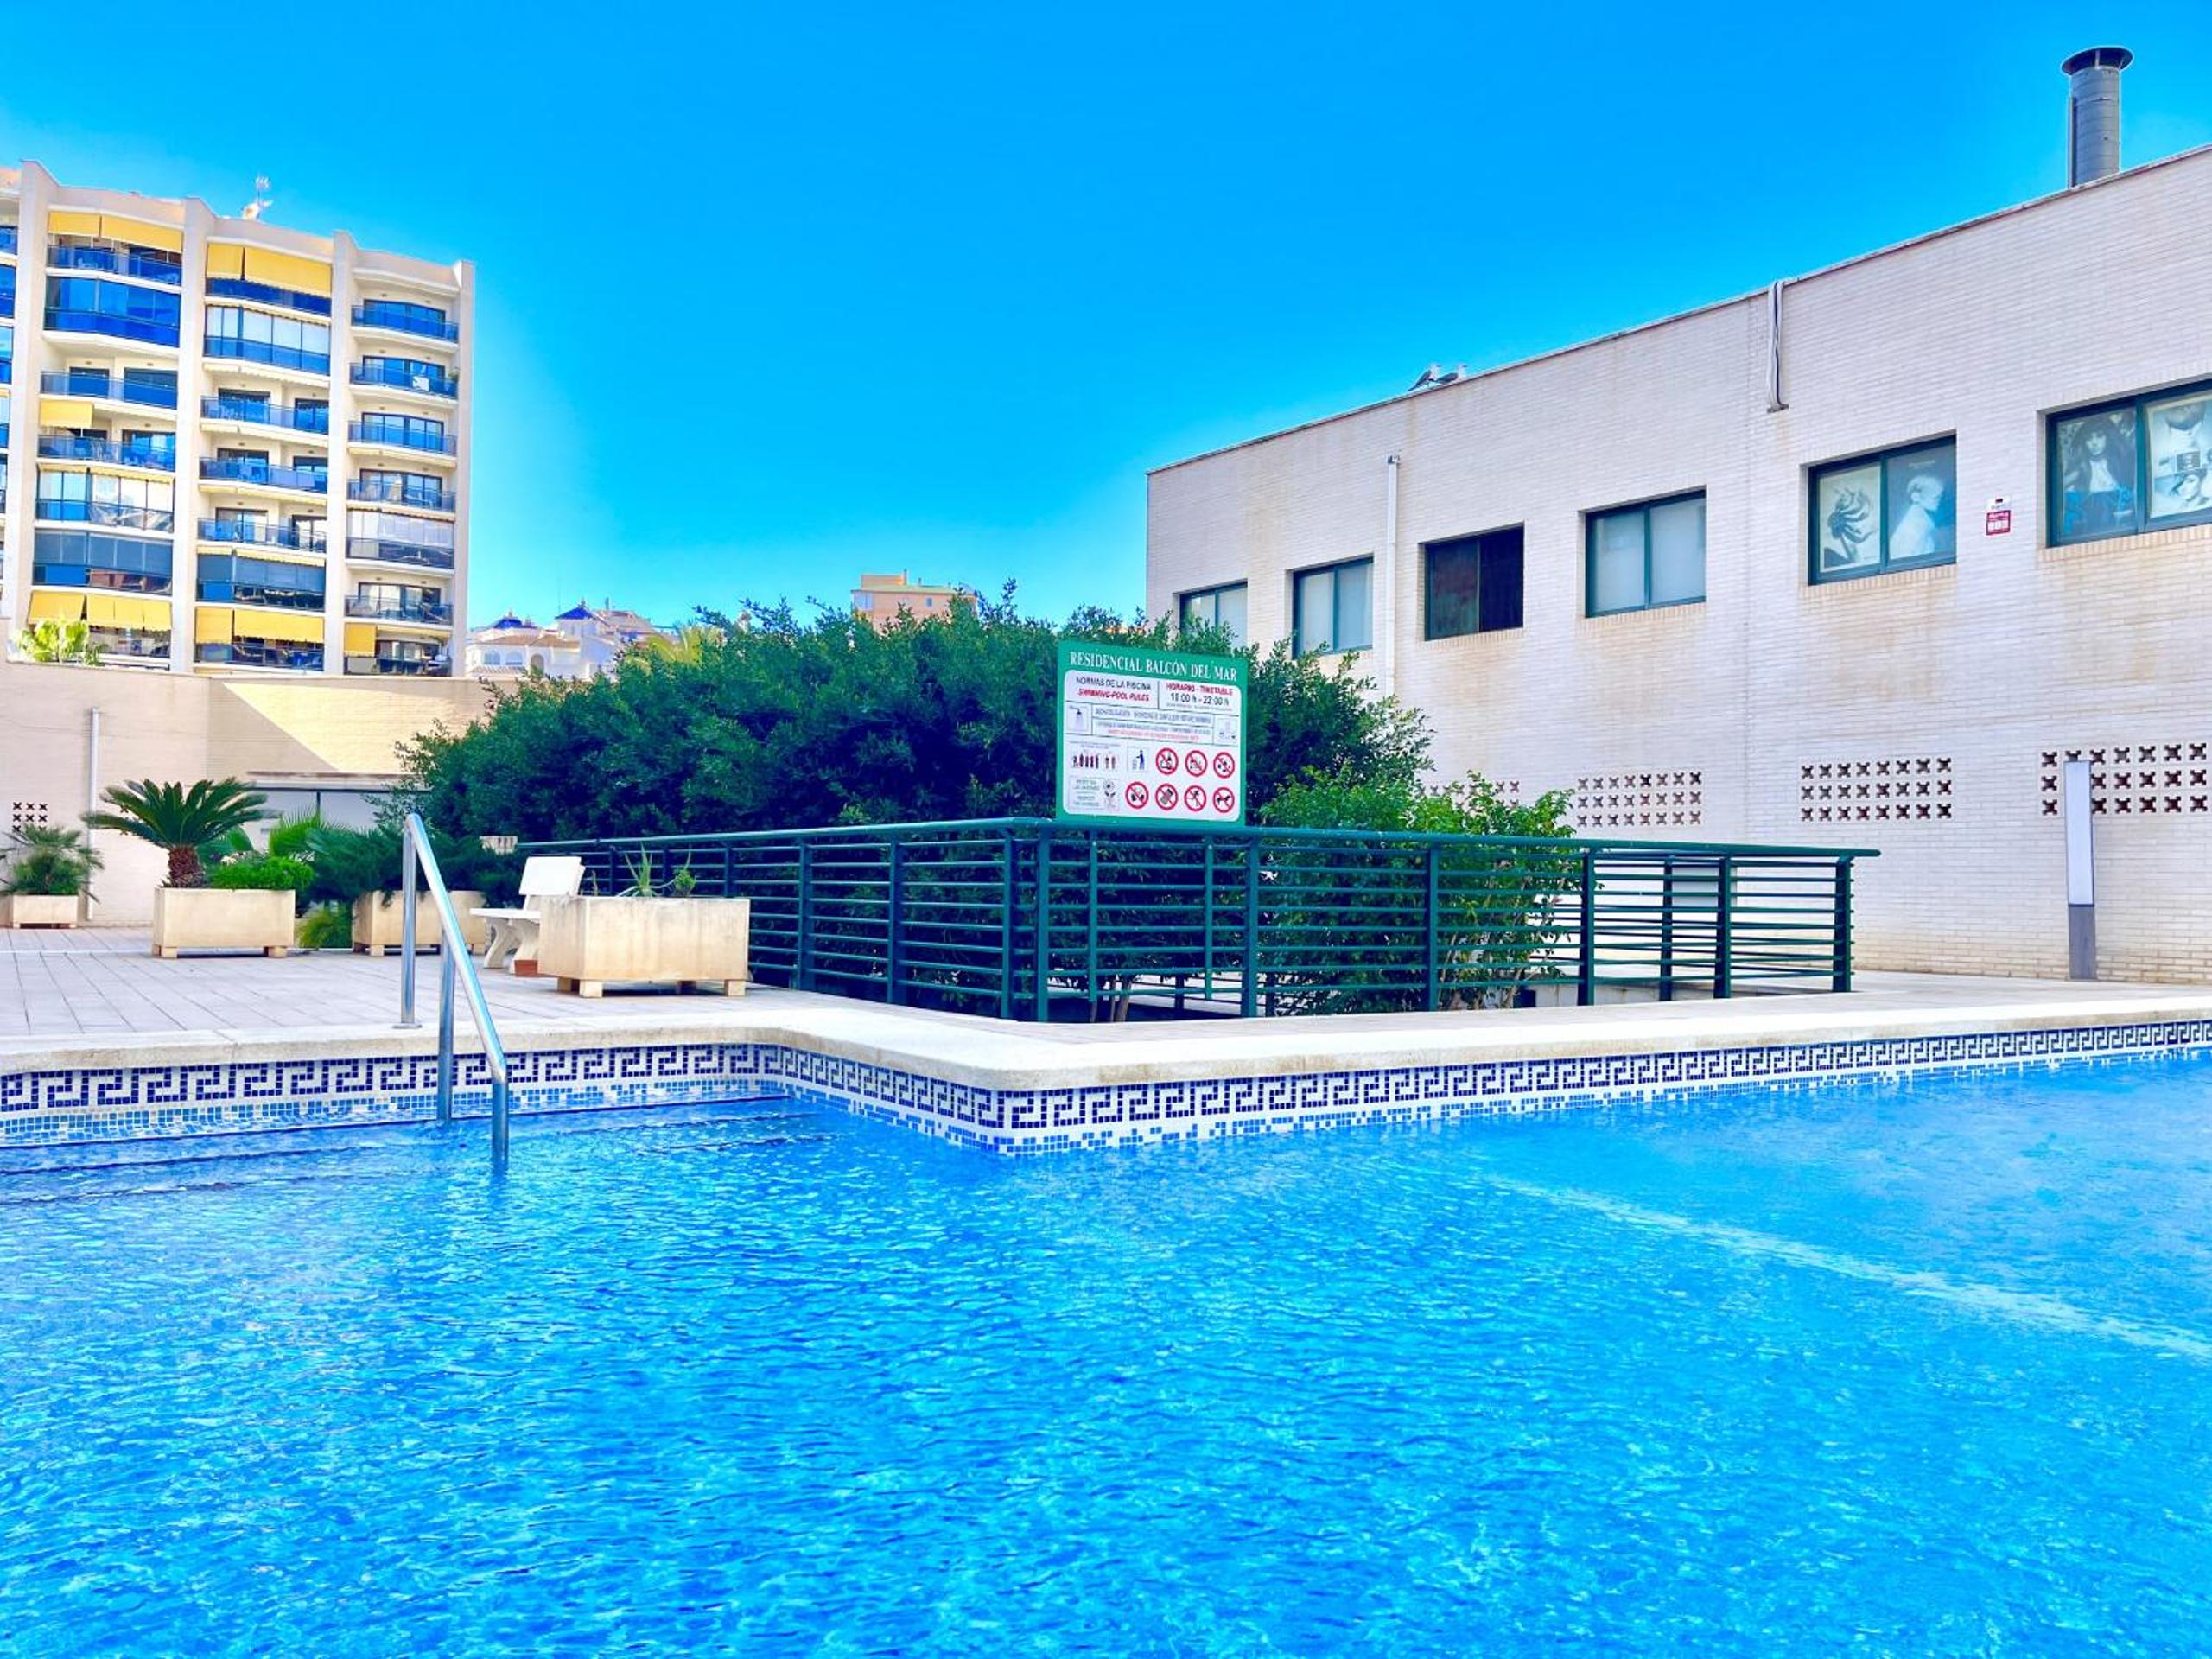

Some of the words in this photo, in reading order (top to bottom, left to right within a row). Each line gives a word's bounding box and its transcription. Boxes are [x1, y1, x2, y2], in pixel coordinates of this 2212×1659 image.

[1070, 652, 1142, 671] RESIDENCIAL
[1147, 658, 1187, 676] BALCÓN
[1191, 664, 1211, 678] DEL
[1214, 666, 1236, 682] MAR
[1076, 676, 1104, 687] NORMAS
[1106, 679, 1115, 688] DE
[1116, 680, 1125, 689] LA
[1126, 681, 1151, 690] PISCINA
[1166, 683, 1195, 692] HORARIO
[1200, 685, 1233, 696] TIMETABLE
[1129, 693, 1150, 702] RULES
